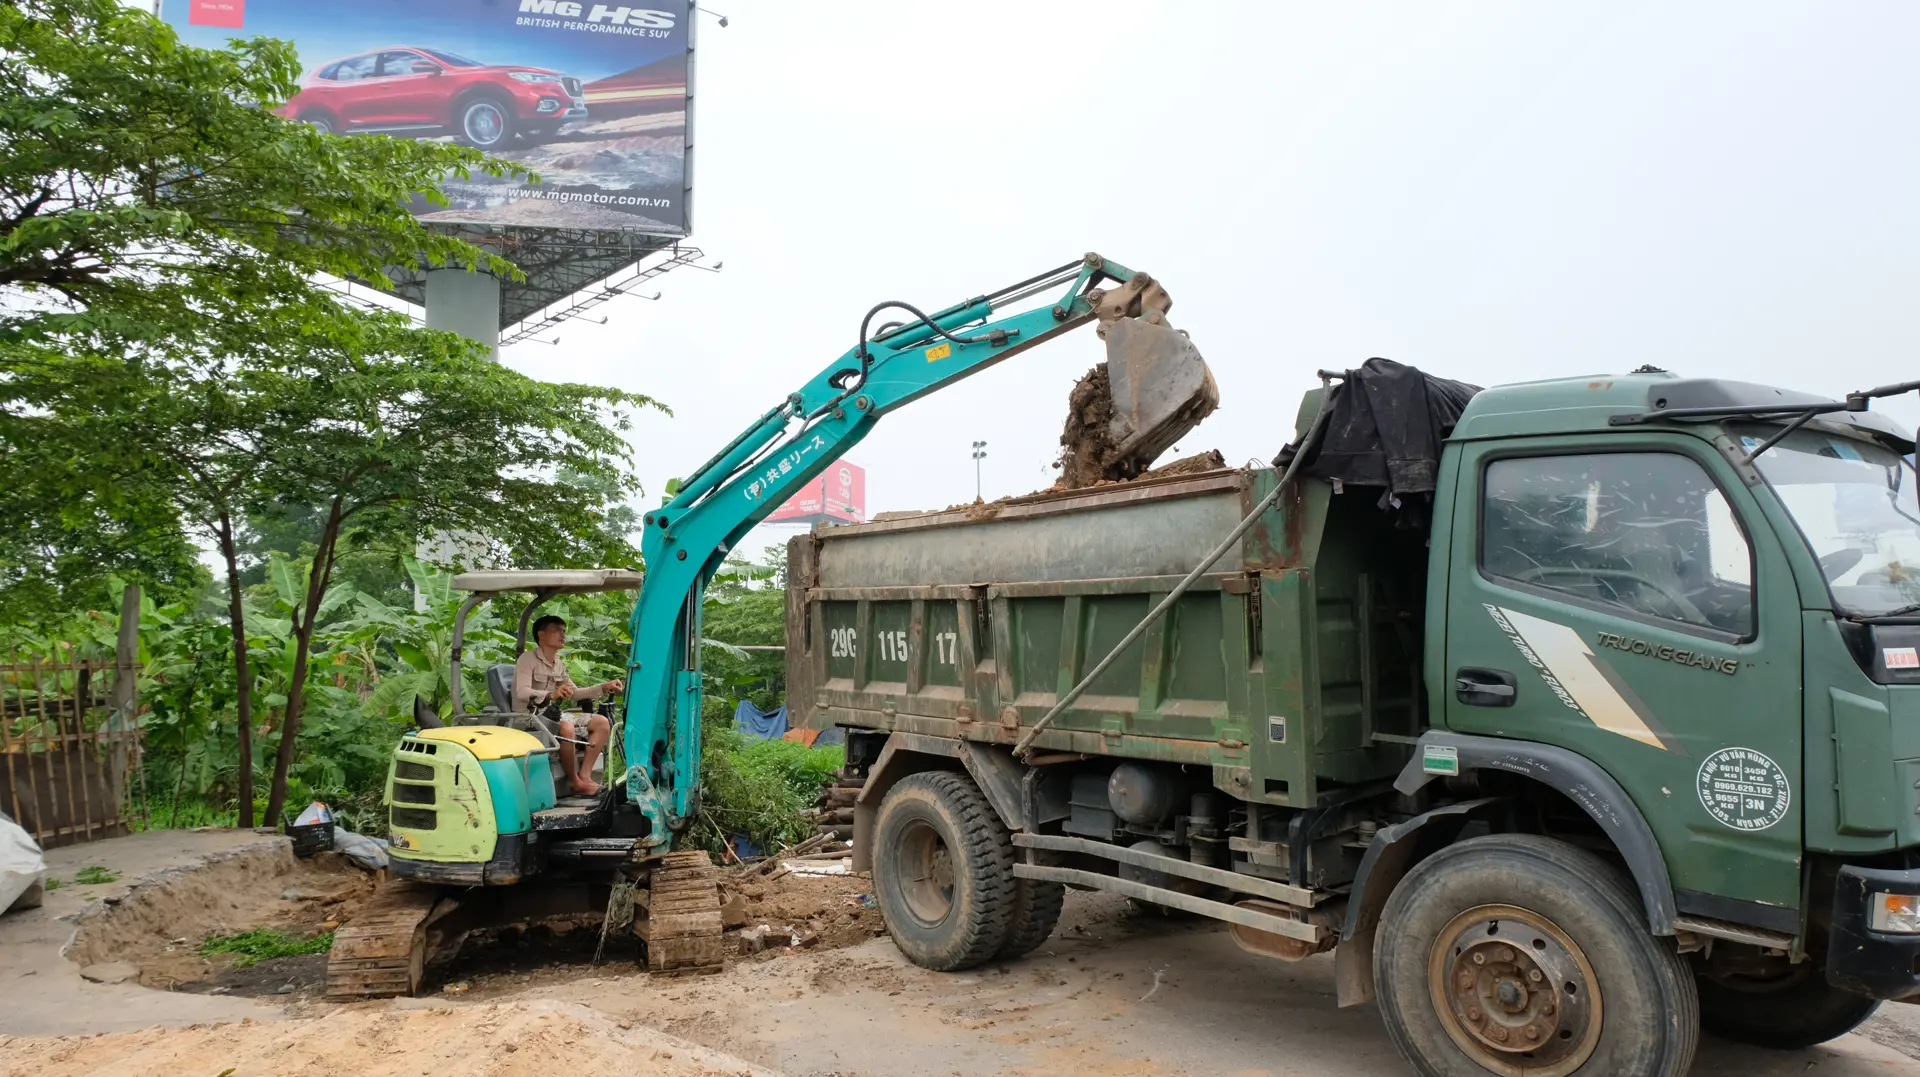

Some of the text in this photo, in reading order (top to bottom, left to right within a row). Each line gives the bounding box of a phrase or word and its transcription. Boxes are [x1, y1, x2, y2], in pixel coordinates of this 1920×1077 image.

[519, 0, 676, 29] MG HS
[516, 17, 670, 39] BRITISH PERFORMANCE SUV
[508, 187, 671, 208] www.mgmotor.com.vn
[831, 627, 957, 664] 29C 115 17
[1508, 634, 1545, 668] TURBO
[1744, 766, 1767, 776] 3450
[1715, 793, 1739, 803] 9655
[1720, 802, 1735, 810] KG
[1745, 797, 1765, 811] 3N
